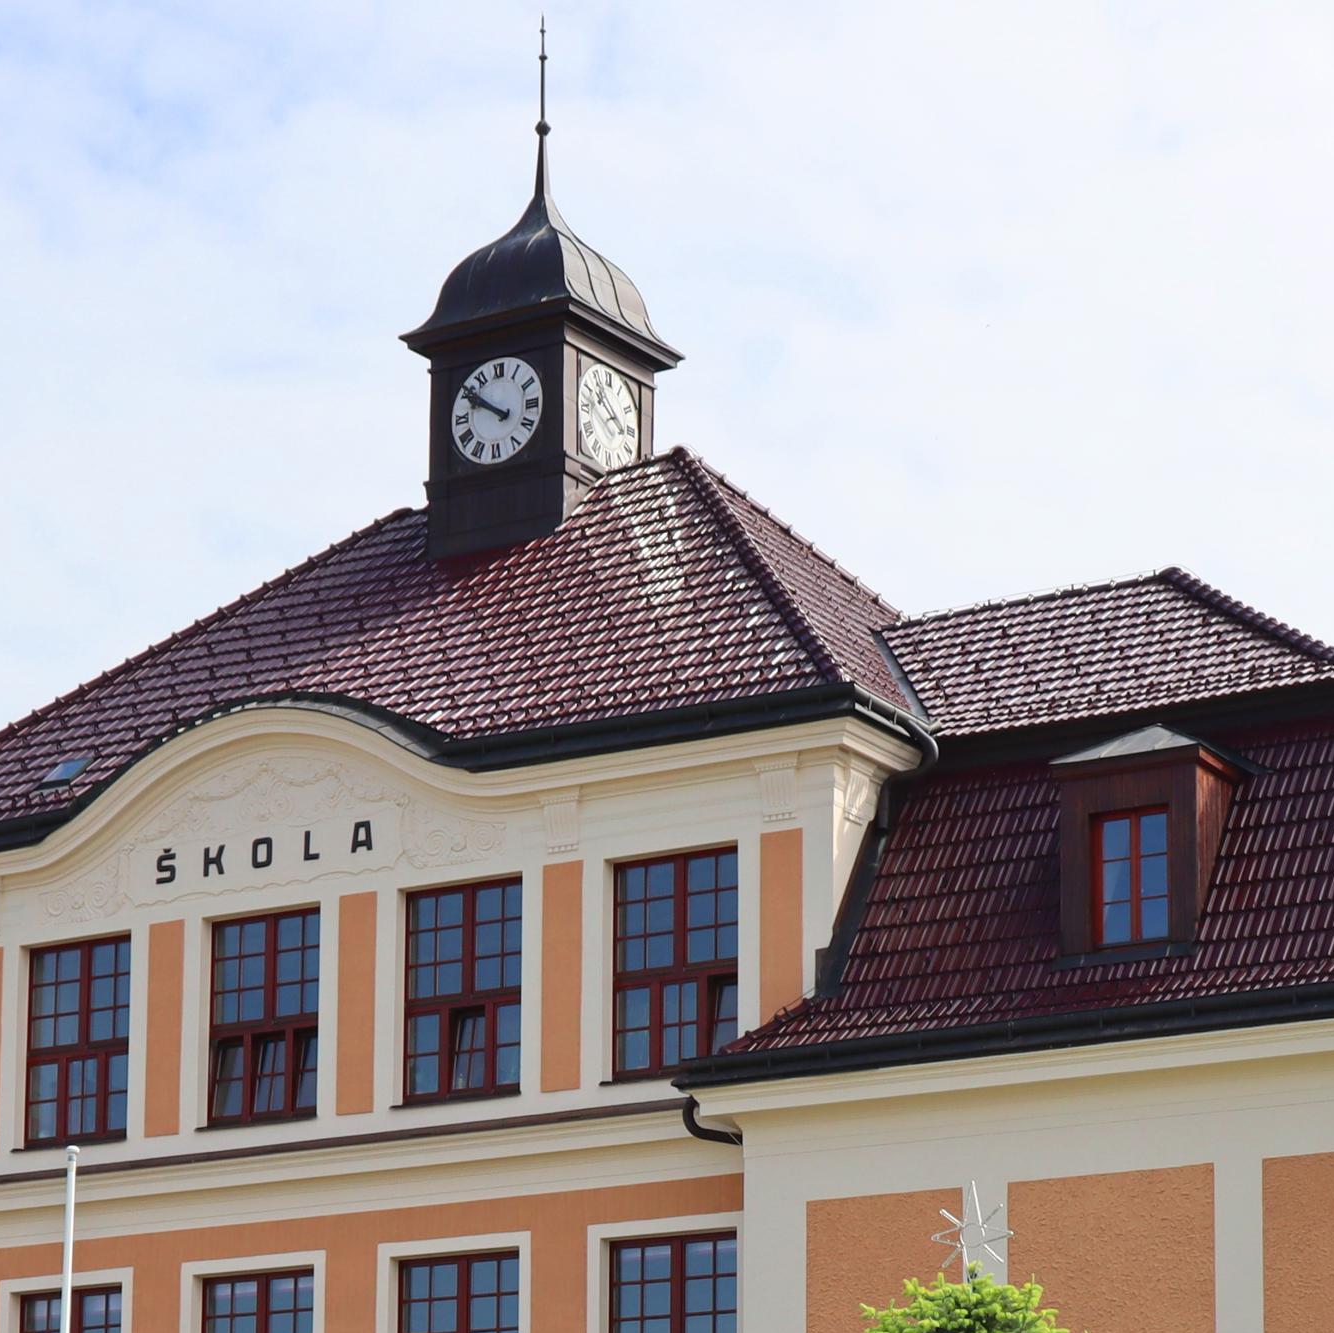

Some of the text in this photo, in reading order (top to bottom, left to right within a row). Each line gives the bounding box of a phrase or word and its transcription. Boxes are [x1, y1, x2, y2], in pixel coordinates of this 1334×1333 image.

[492, 362, 505, 379] XII
[511, 364, 520, 380] I
[474, 370, 488, 388] XI
[521, 376, 536, 392] II
[525, 396, 539, 410] III
[455, 412, 469, 426] IX
[520, 417, 535, 432] IV
[510, 435, 522, 451] V
[156, 820, 373, 885] ŠKOLA
